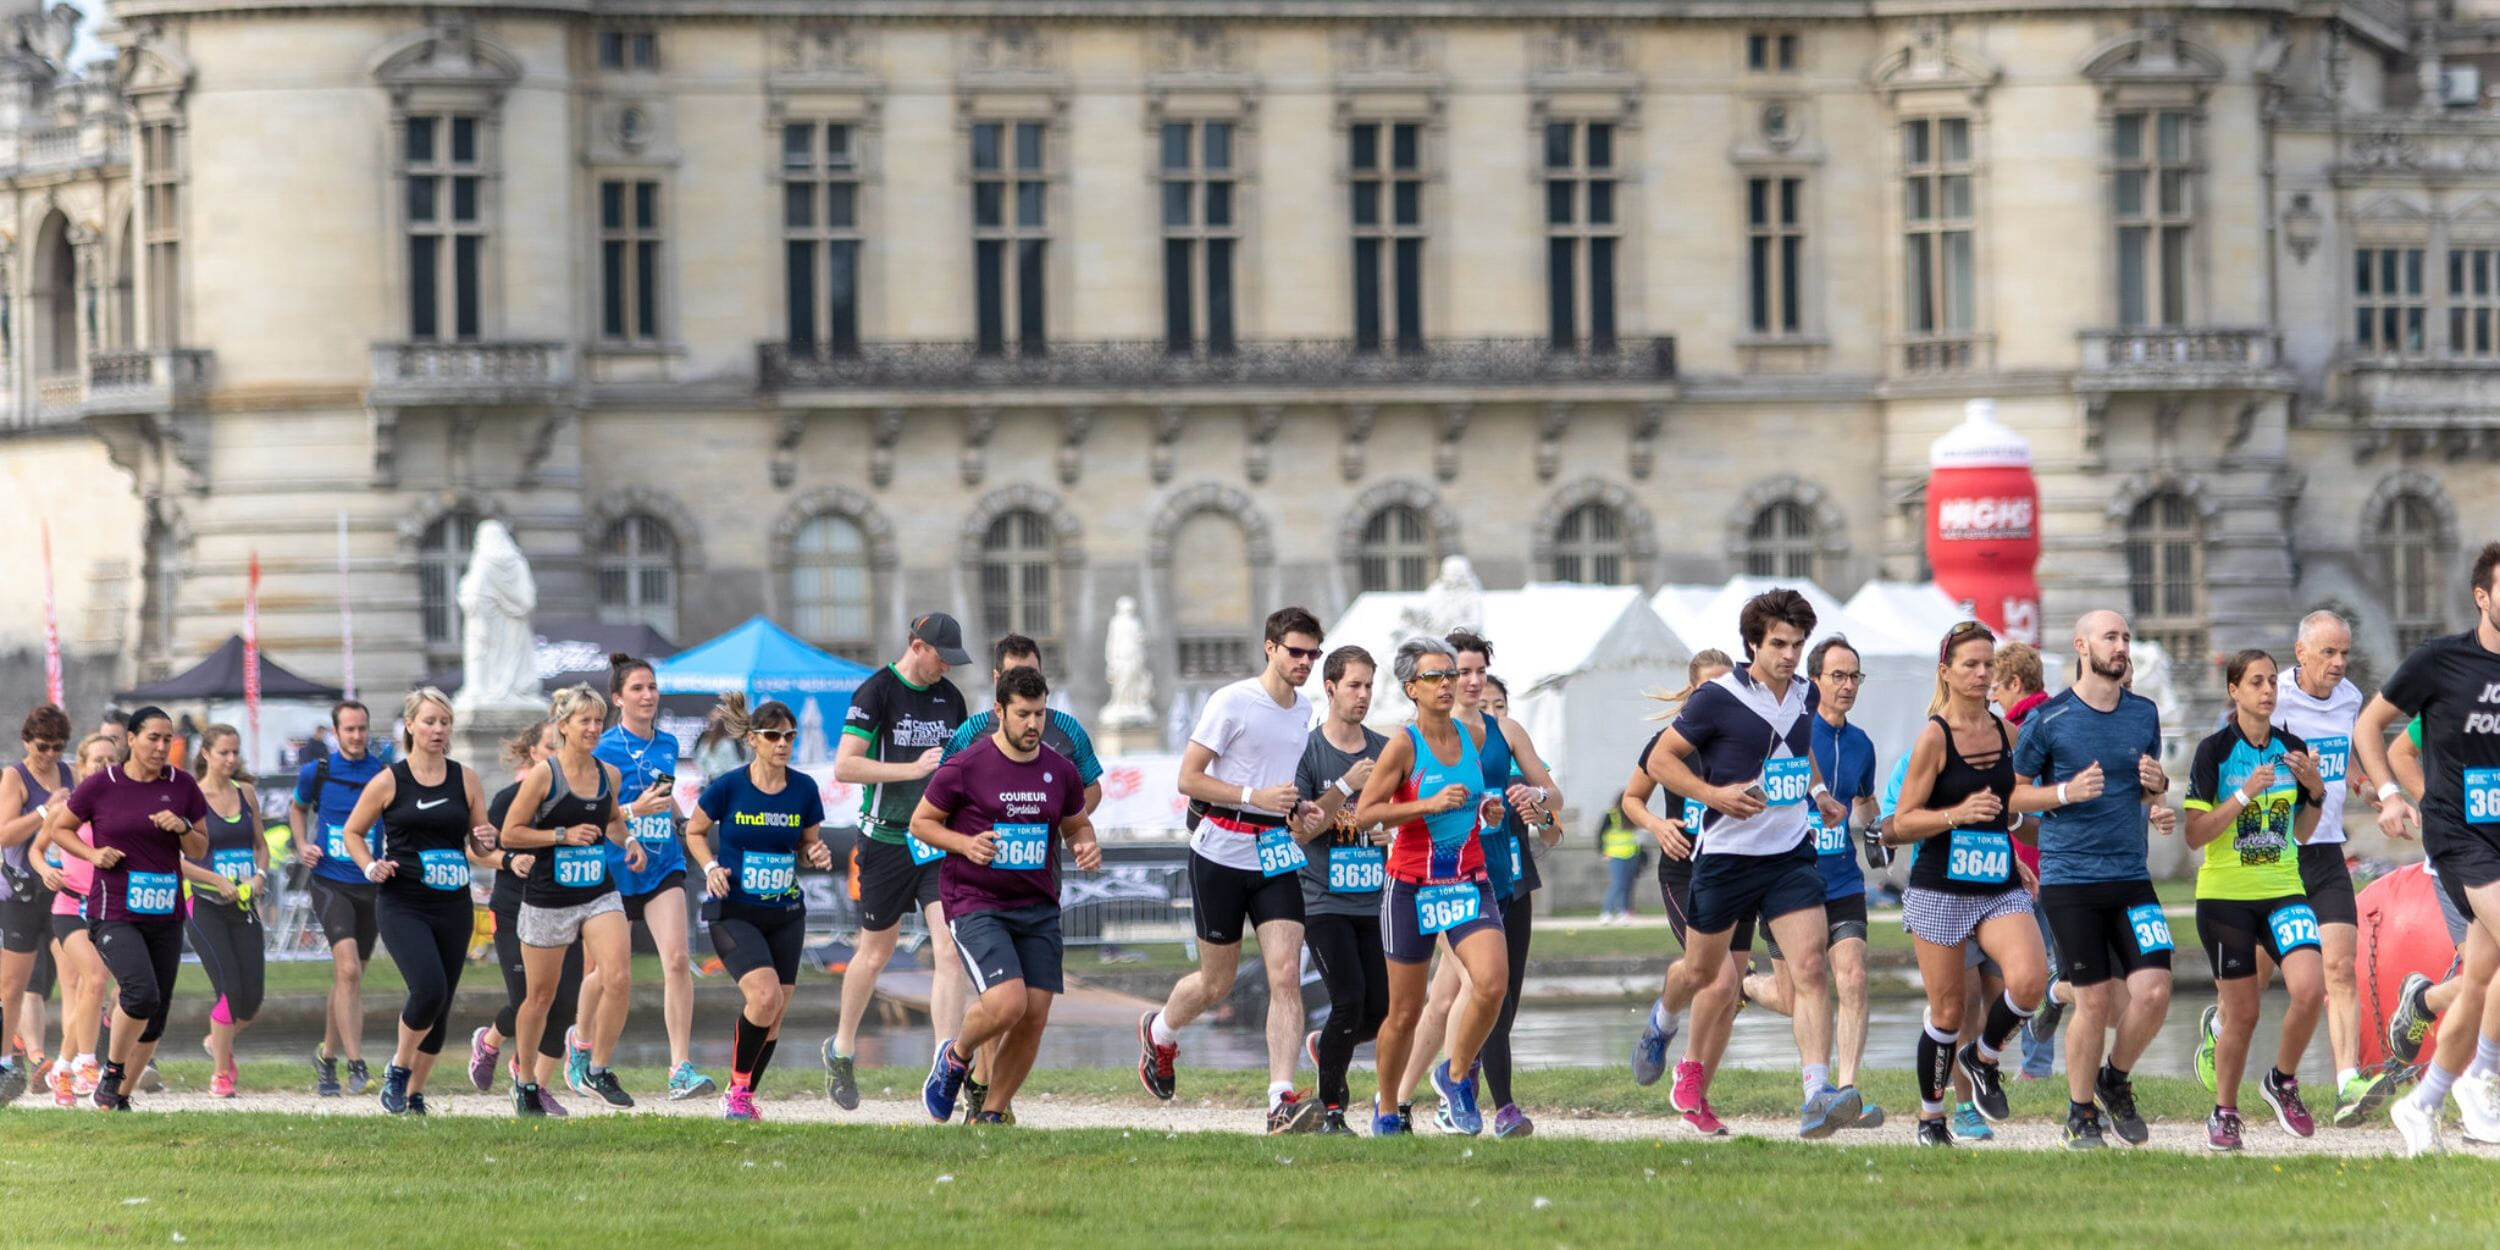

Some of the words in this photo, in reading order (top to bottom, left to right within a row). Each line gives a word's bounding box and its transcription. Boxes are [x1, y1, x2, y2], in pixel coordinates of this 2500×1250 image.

[913, 720, 945, 732] CASTLE
[913, 729, 957, 739] TRIATHLO
[2317, 752, 2345, 778] 574
[999, 792, 1047, 802] COUREUR
[628, 817, 671, 838] 3623
[994, 840, 1046, 864] 3646
[1951, 848, 2008, 877] 3644
[424, 864, 469, 887] 3630
[560, 860, 602, 882] 3718
[743, 867, 794, 890] 3696
[1331, 863, 1383, 888] 3636
[130, 886, 175, 910] 3664
[1421, 898, 1476, 928] 3651
[2278, 918, 2320, 947] 372
